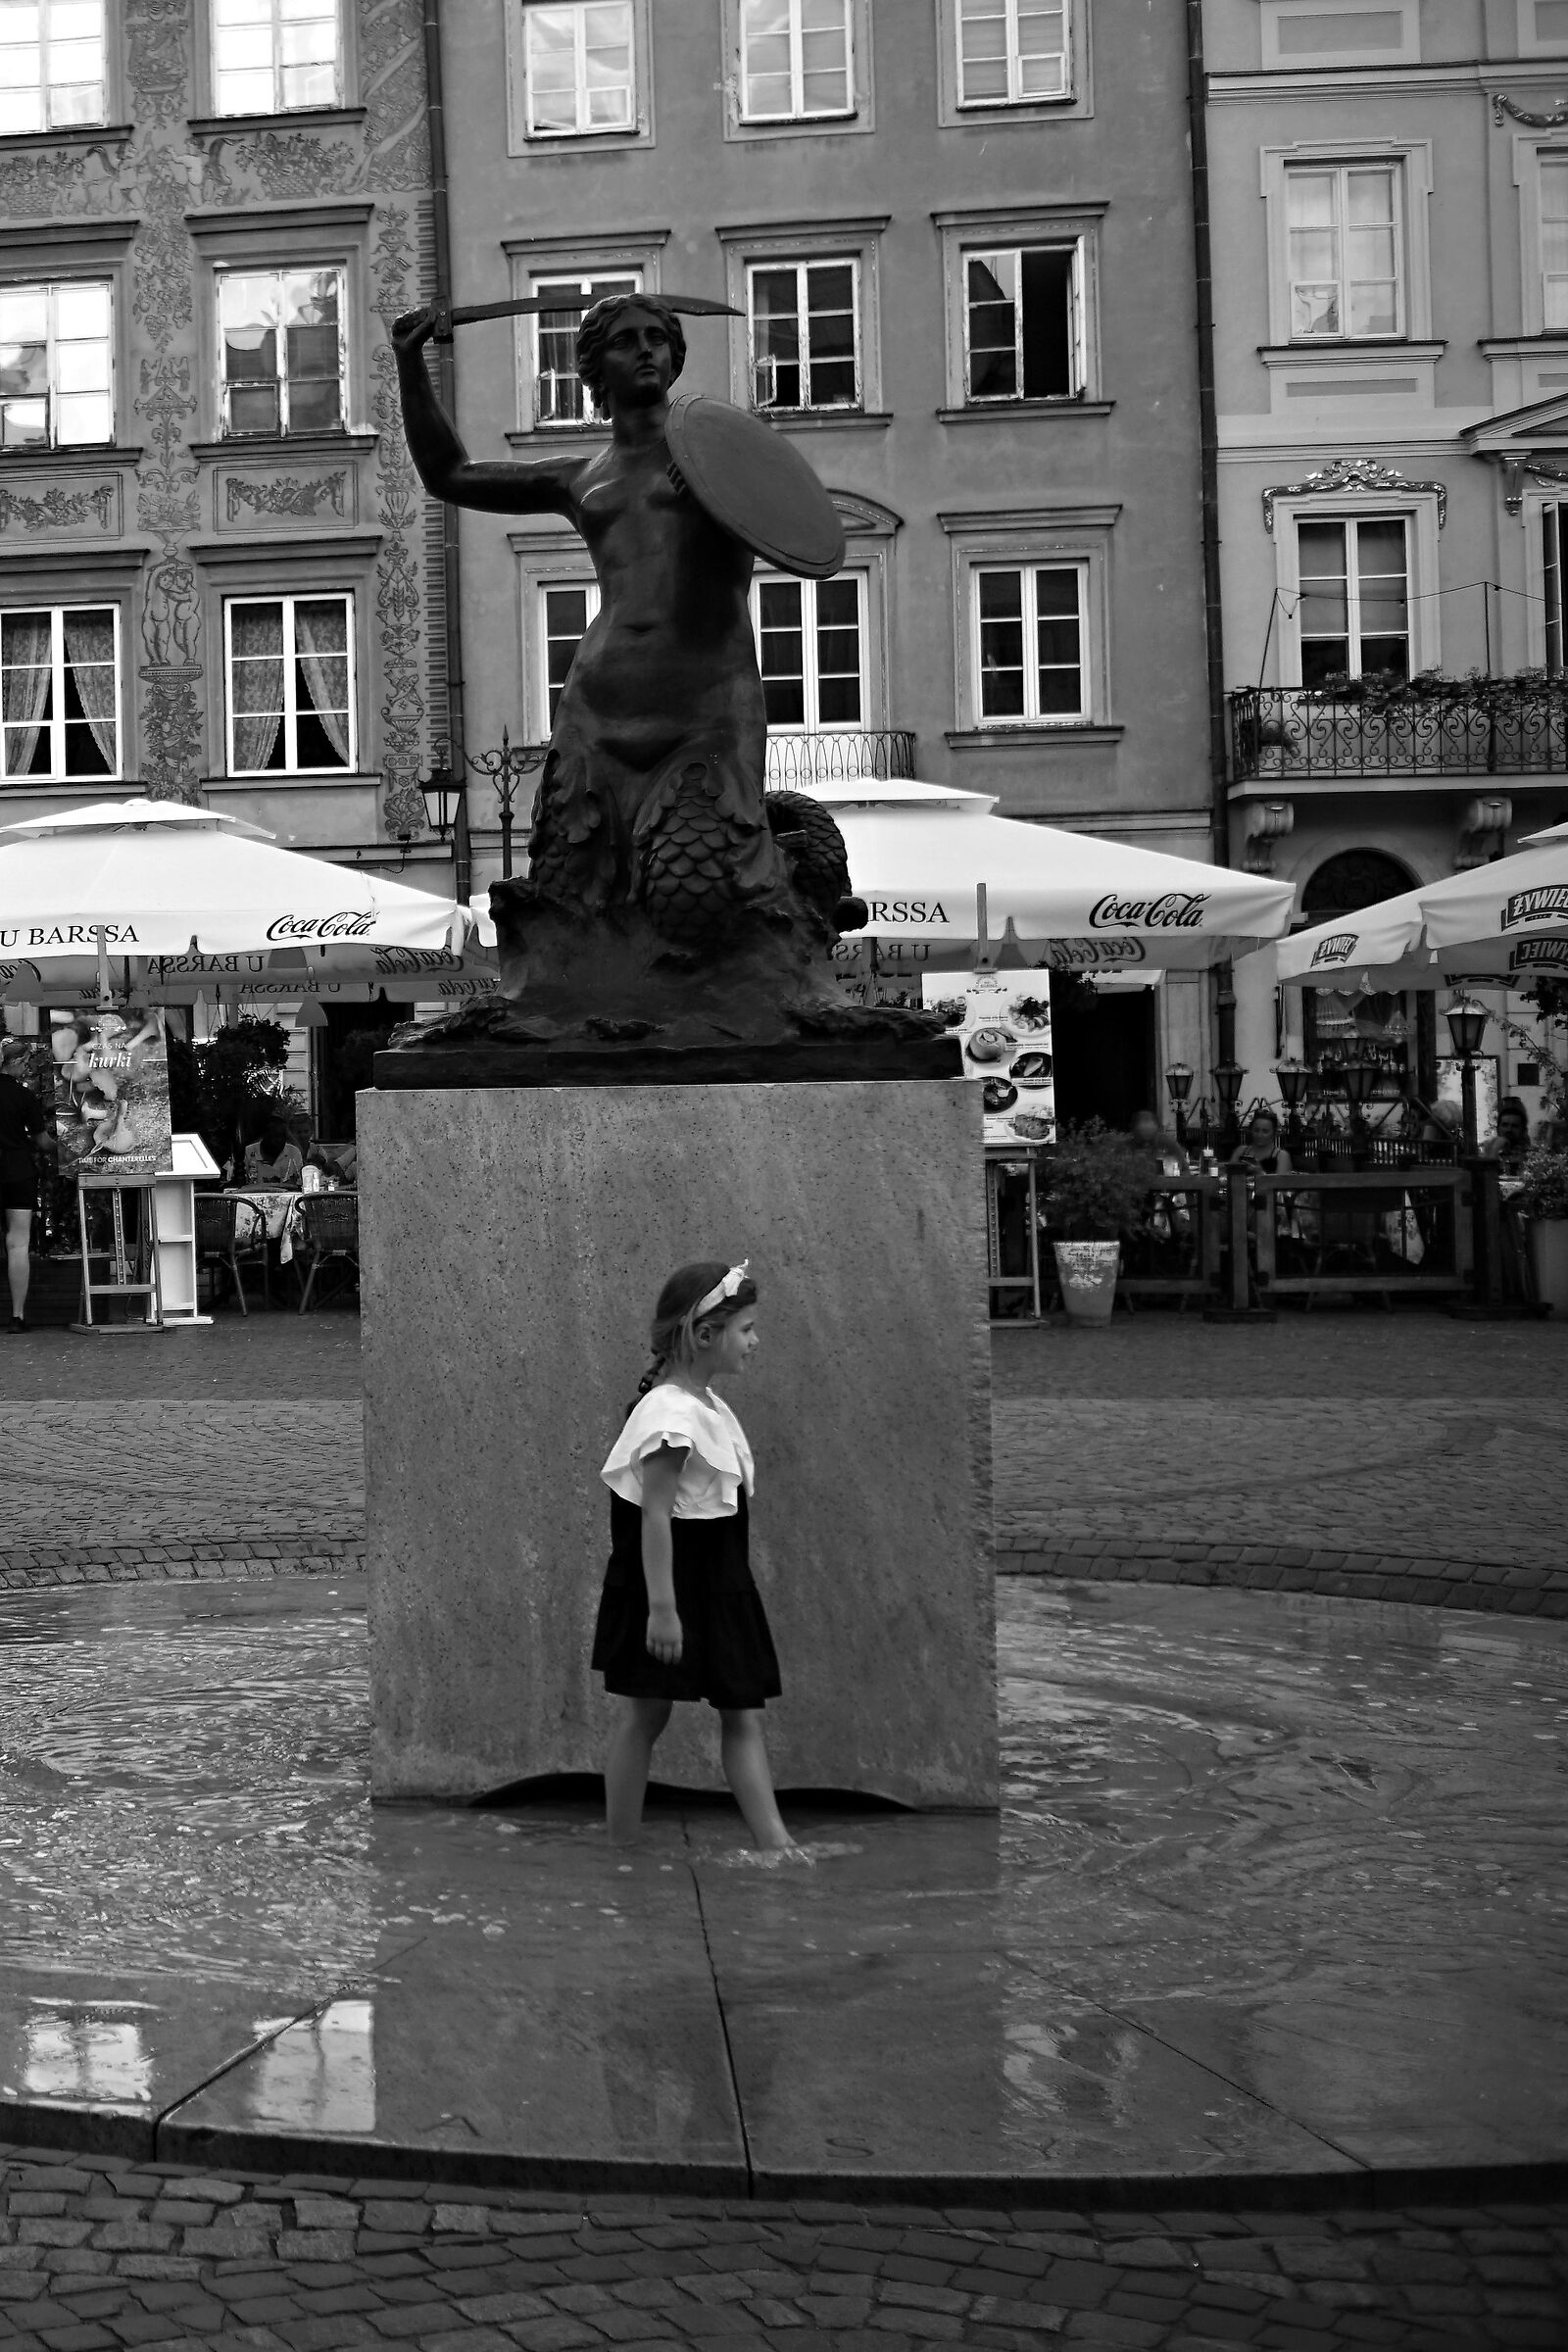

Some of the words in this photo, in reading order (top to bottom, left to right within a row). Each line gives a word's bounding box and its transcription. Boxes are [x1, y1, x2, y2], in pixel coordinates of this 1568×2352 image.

[867, 901, 950, 923] RSSA
[1089, 893, 1212, 928] Coca-Cola
[1512, 887, 1568, 917] ŻYWIE
[0, 929, 20, 948] U
[27, 924, 139, 946] BARSSA
[266, 911, 380, 942] Coca-Cola
[88, 1052, 131, 1068] kurki
